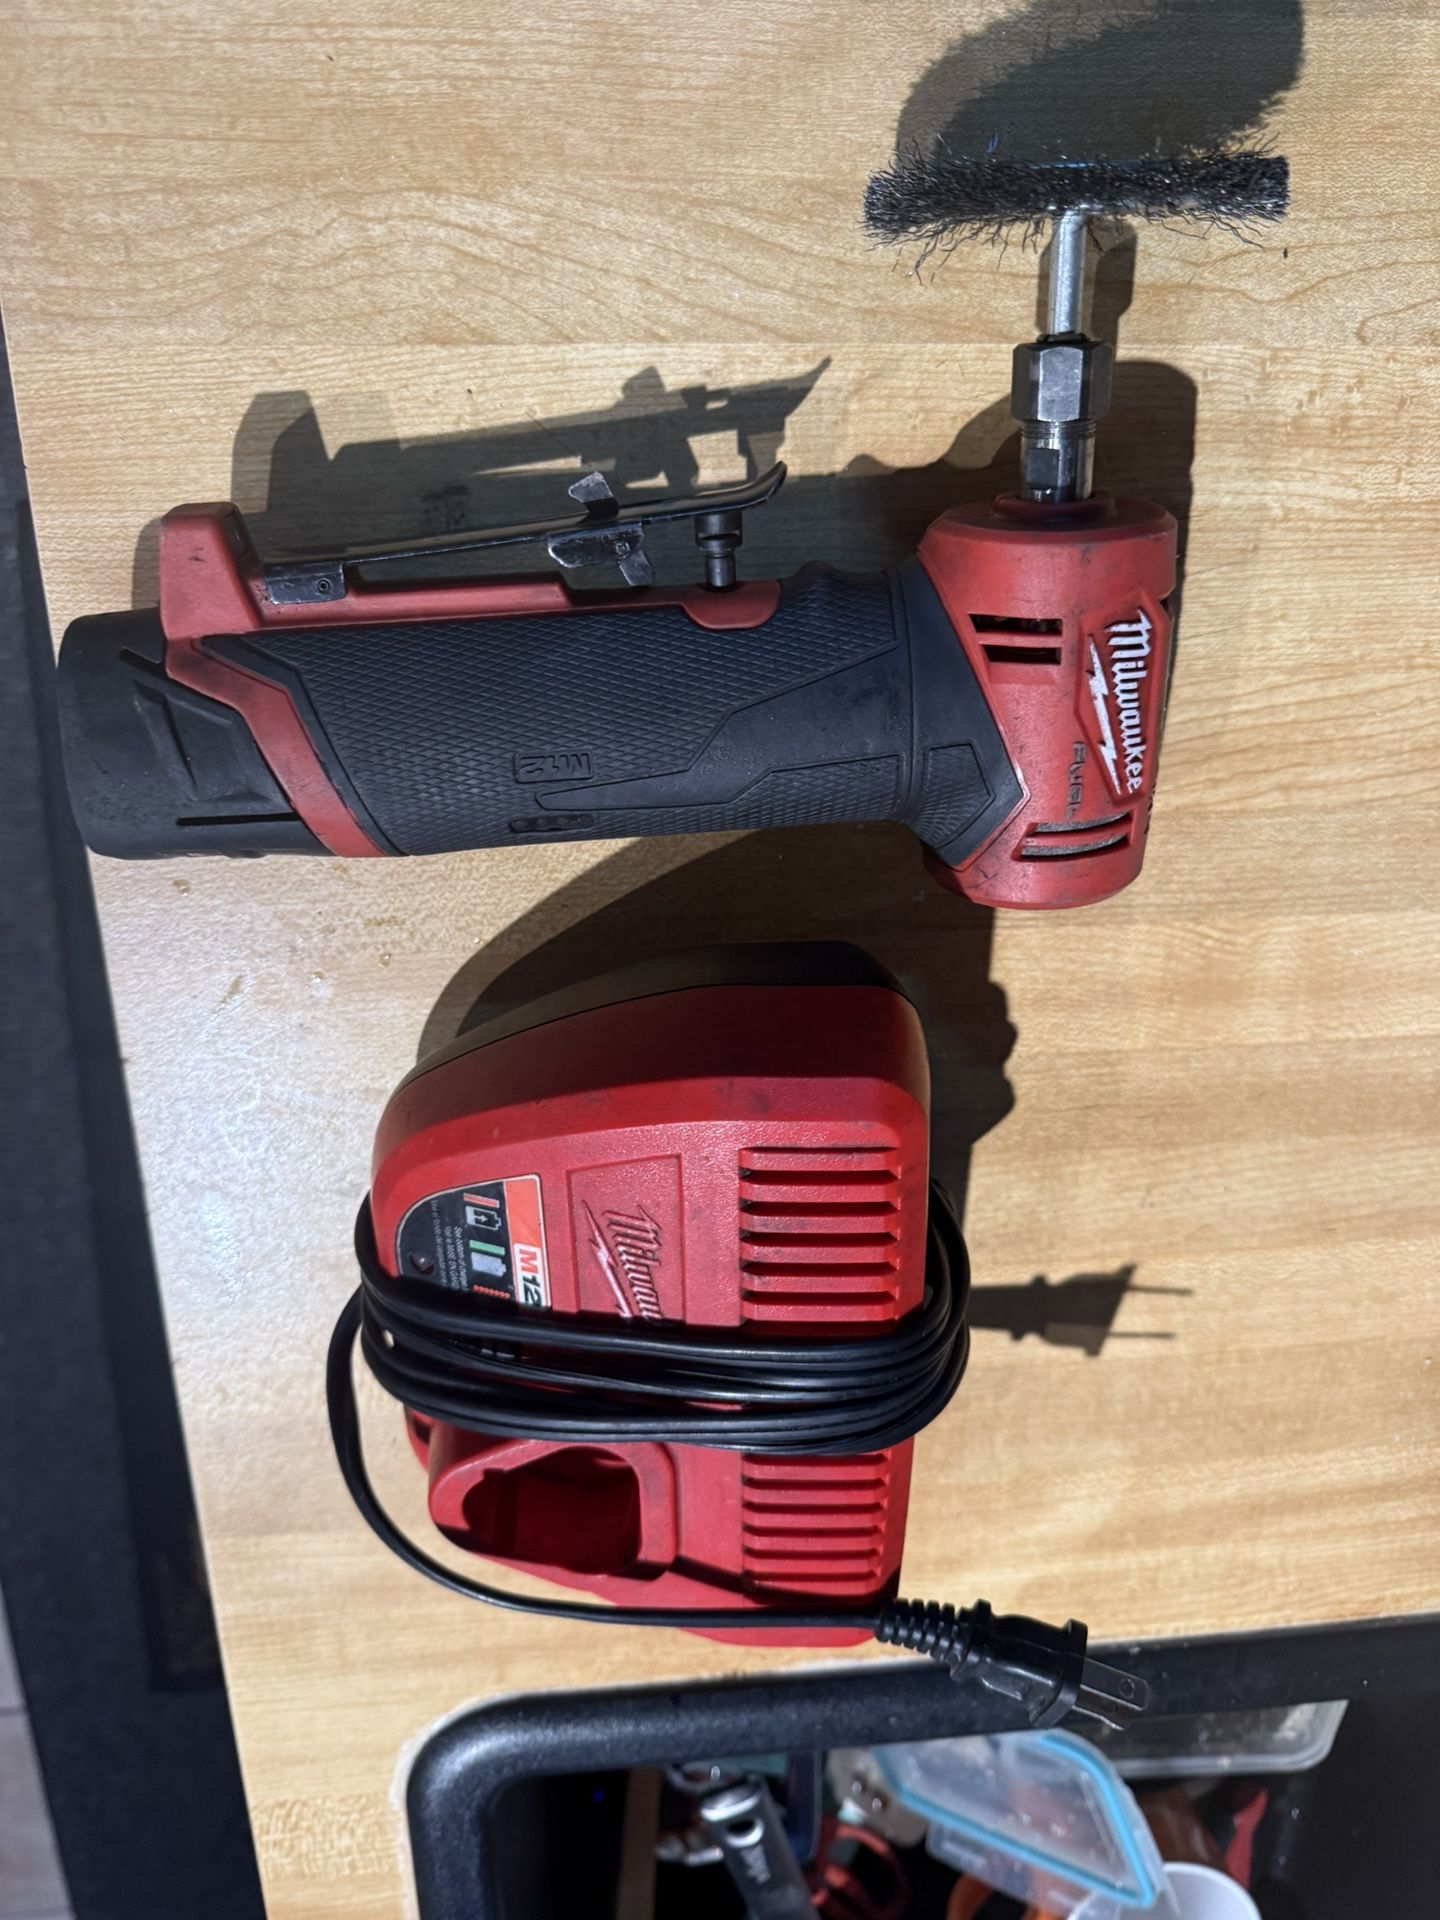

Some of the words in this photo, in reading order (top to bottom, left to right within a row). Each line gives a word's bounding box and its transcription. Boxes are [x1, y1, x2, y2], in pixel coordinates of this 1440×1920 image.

[1103, 608, 1153, 794] Milwaukee
[1067, 741, 1088, 819] FUEL
[519, 1248, 541, 1307] M12
[602, 1204, 663, 1319] Milwau
